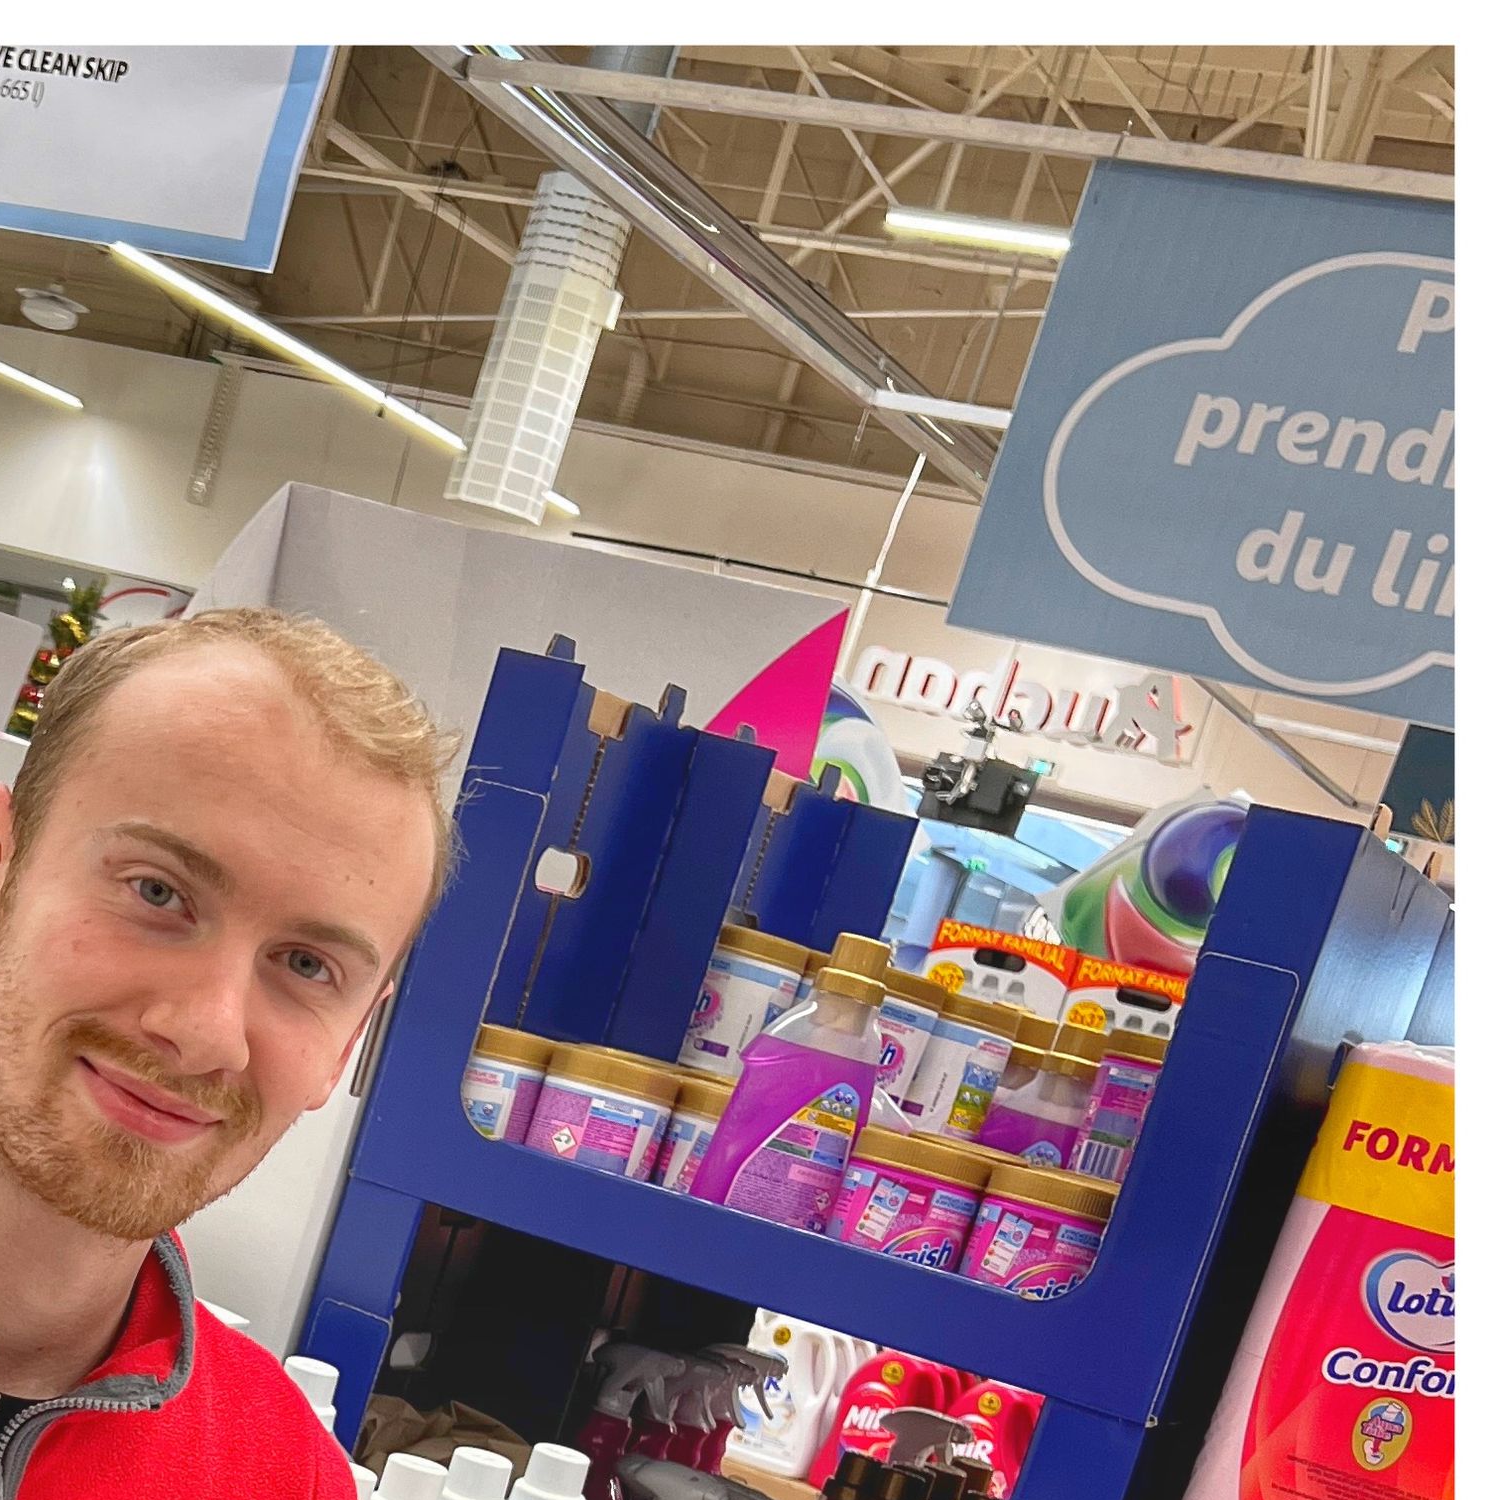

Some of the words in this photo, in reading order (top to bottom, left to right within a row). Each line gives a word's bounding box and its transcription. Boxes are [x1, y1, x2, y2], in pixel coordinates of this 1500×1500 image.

[17, 48, 81, 77] CLEAN
[82, 56, 129, 83] SKIP
[1173, 393, 1455, 490] prend
[1235, 510, 1354, 597] du
[938, 921, 1002, 947] FORMAT
[1002, 931, 1067, 973] FAMILIAL
[1343, 1119, 1455, 1182] FORM
[1387, 1281, 1455, 1317] lotu
